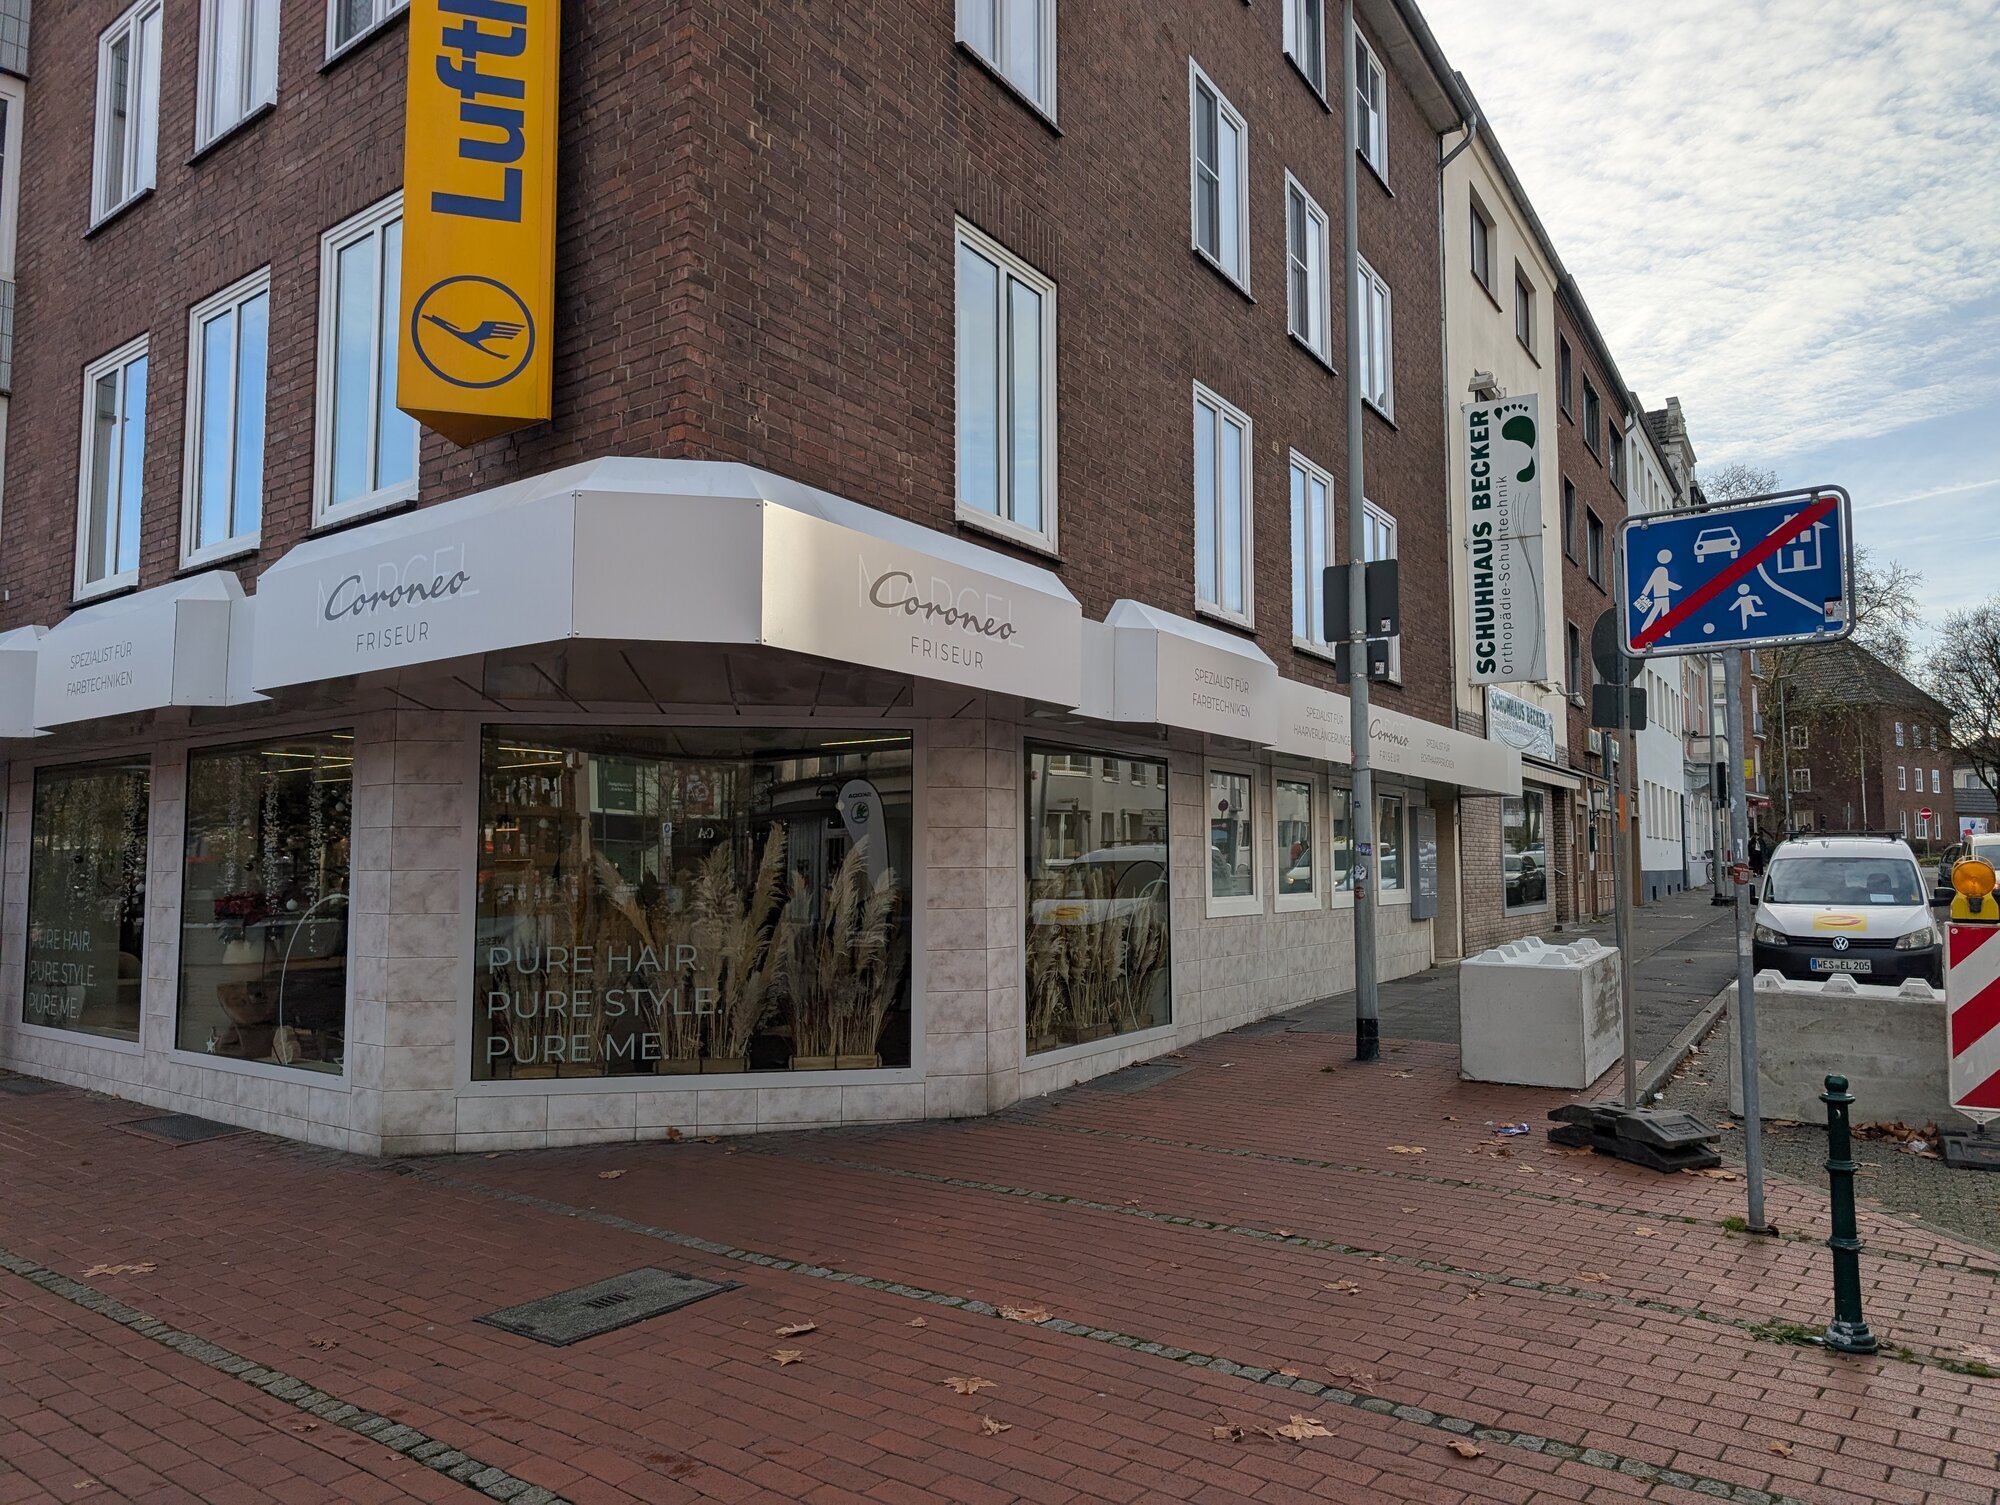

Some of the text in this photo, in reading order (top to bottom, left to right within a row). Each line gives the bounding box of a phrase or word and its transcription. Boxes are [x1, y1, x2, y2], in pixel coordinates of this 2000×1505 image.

[1470, 409, 1497, 675] SCHUHHAUS BECKER
[1495, 475, 1514, 675] Orthopädie-Schuhtechnik
[325, 571, 471, 621] Coroneo
[858, 554, 1025, 649] MARCEL
[869, 571, 1017, 640] Coroneo
[356, 621, 430, 652] FRISEUR
[70, 640, 133, 669] SPEZIALIST FÜR
[911, 636, 984, 670] FRISEUR
[67, 670, 133, 696] FARBTECHNIKEN
[1194, 667, 1250, 695] SPEZIALIST FÜR
[1192, 692, 1250, 718] FARBTECHNIKEN
[1369, 718, 1409, 747] Coroneo
[31, 928, 92, 952] PURE HAIR.
[30, 960, 97, 987] PURE STYLE.
[489, 944, 705, 975] PURE HAIR.
[1817, 960, 1870, 971] WES EL 205
[28, 992, 80, 1019] PURE ME.
[488, 988, 723, 1019] PURE STYLE.
[486, 1032, 670, 1064] PURE ME.
